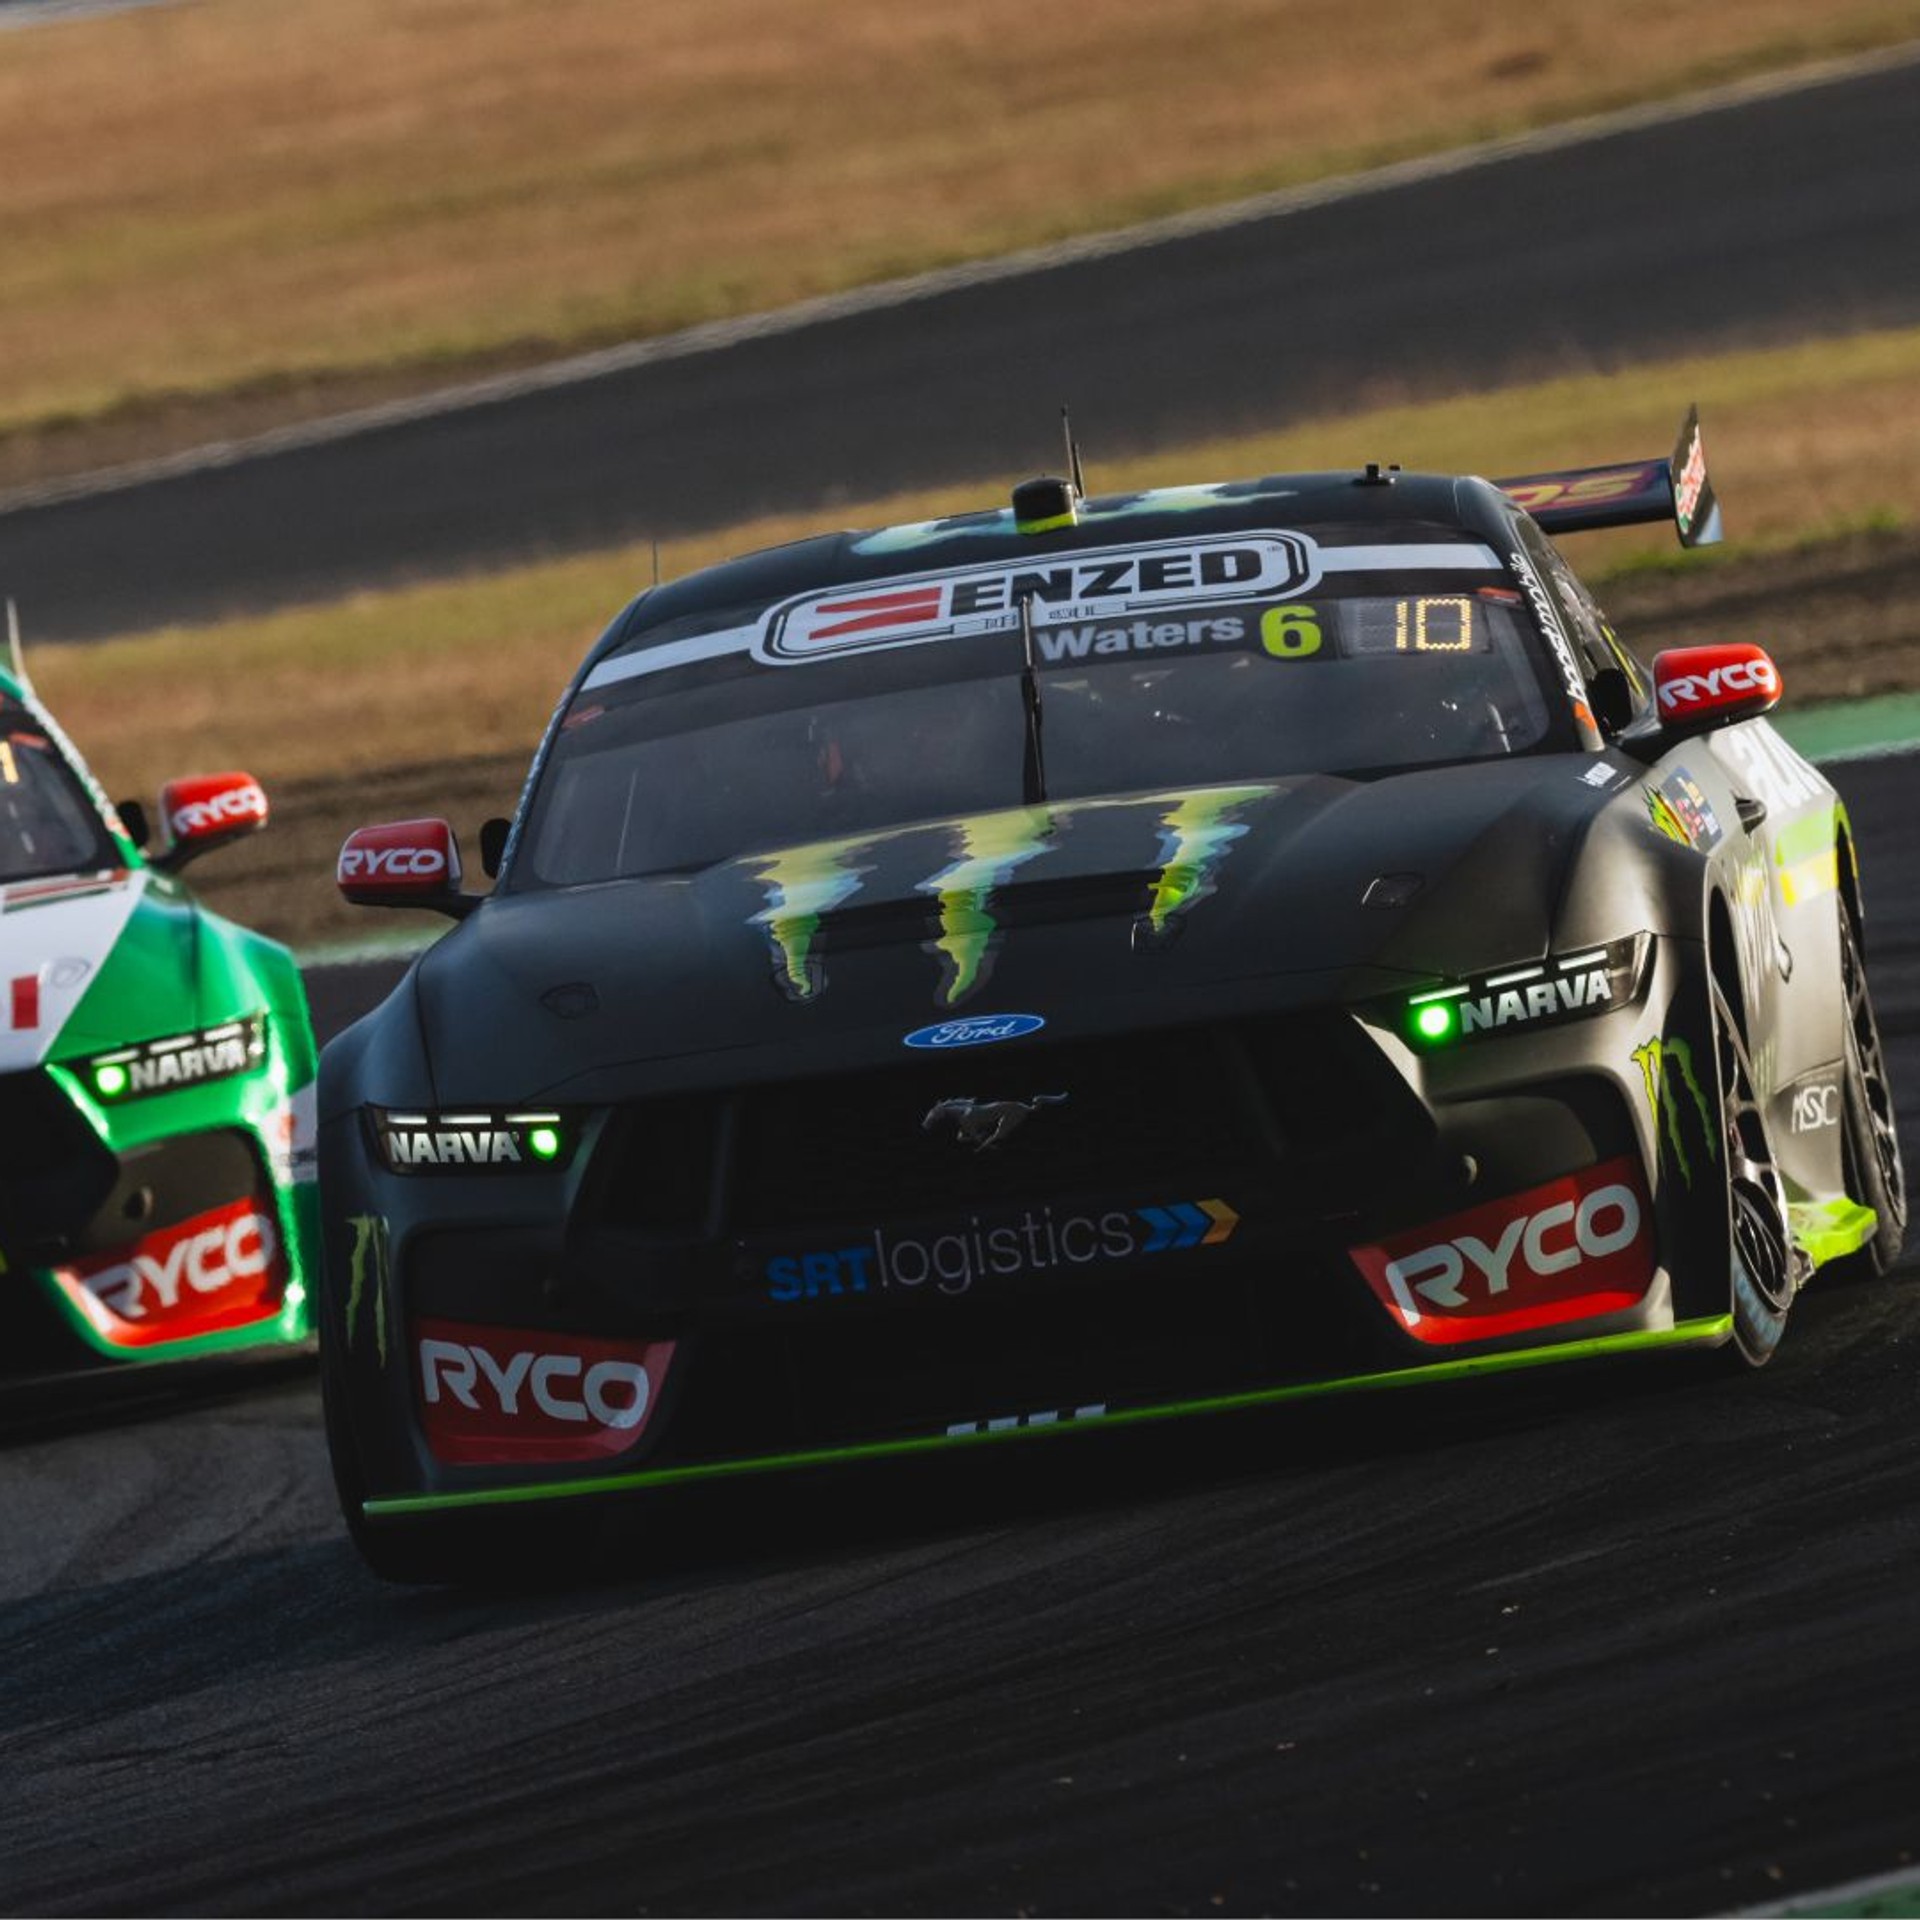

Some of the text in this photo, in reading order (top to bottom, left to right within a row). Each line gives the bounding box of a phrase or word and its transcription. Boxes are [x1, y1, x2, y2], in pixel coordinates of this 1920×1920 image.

[949, 547, 1263, 618] ENZED
[1039, 614, 1244, 662] Waters
[1259, 604, 1323, 658] 6
[1395, 597, 1473, 651] 10
[1658, 657, 1777, 708] RYCO
[172, 785, 267, 833] RYCO
[341, 847, 445, 876] RYCO
[1459, 969, 1613, 1035] NARVA
[932, 1017, 1015, 1045] Ford
[130, 1037, 244, 1092] NARVA
[388, 1131, 521, 1164] NARVA
[82, 1211, 274, 1317] RYCO
[1385, 1183, 1641, 1325] RYCO
[420, 1338, 650, 1429] RYCO
